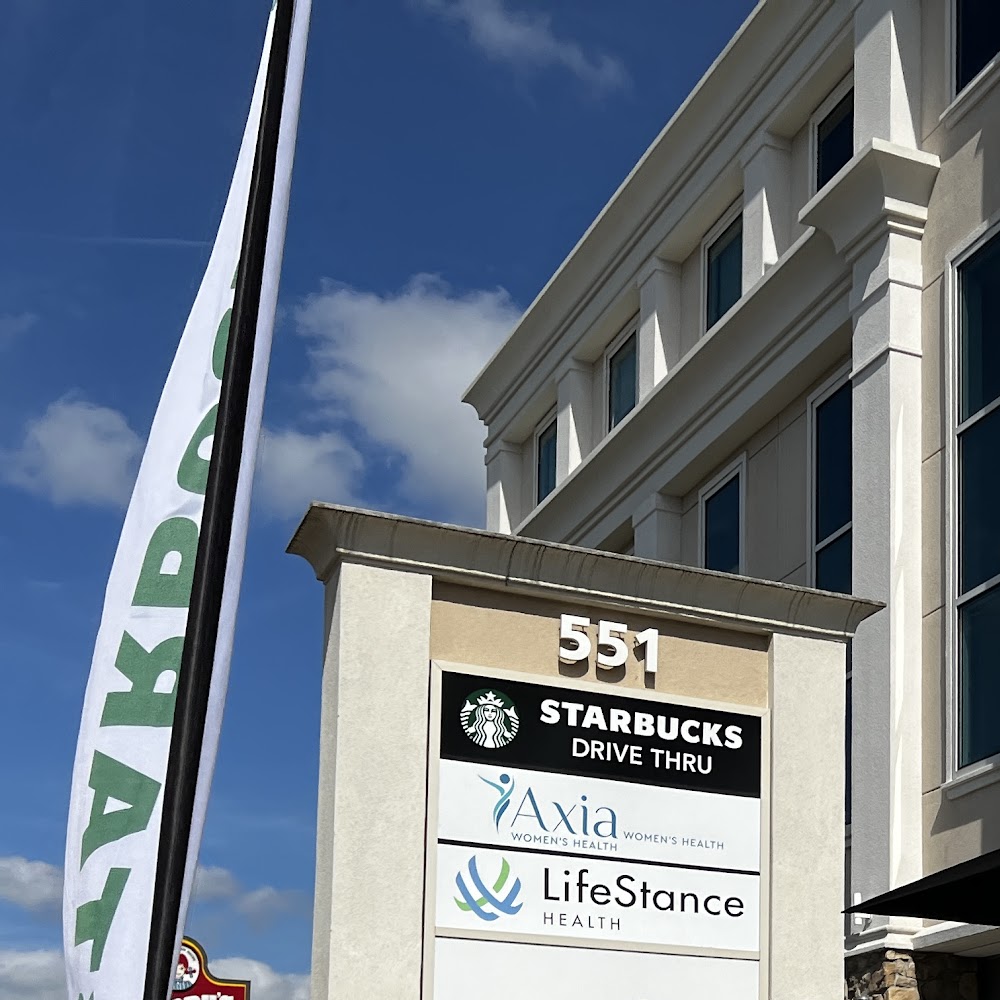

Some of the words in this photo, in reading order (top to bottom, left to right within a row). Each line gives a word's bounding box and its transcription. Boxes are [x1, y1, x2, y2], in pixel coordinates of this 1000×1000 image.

[559, 613, 659, 673] 551
[539, 698, 743, 749] STARBUCKS
[571, 737, 643, 766] DRIVE
[650, 748, 713, 775] THRU
[510, 786, 618, 839] Axia
[511, 831, 568, 847] WOMEN'S
[573, 839, 618, 852] HEALTH
[623, 830, 678, 846] WOMEN'S
[681, 837, 725, 850] HEALTH
[543, 867, 744, 918] LifeStance
[543, 912, 621, 931] HEALTH
